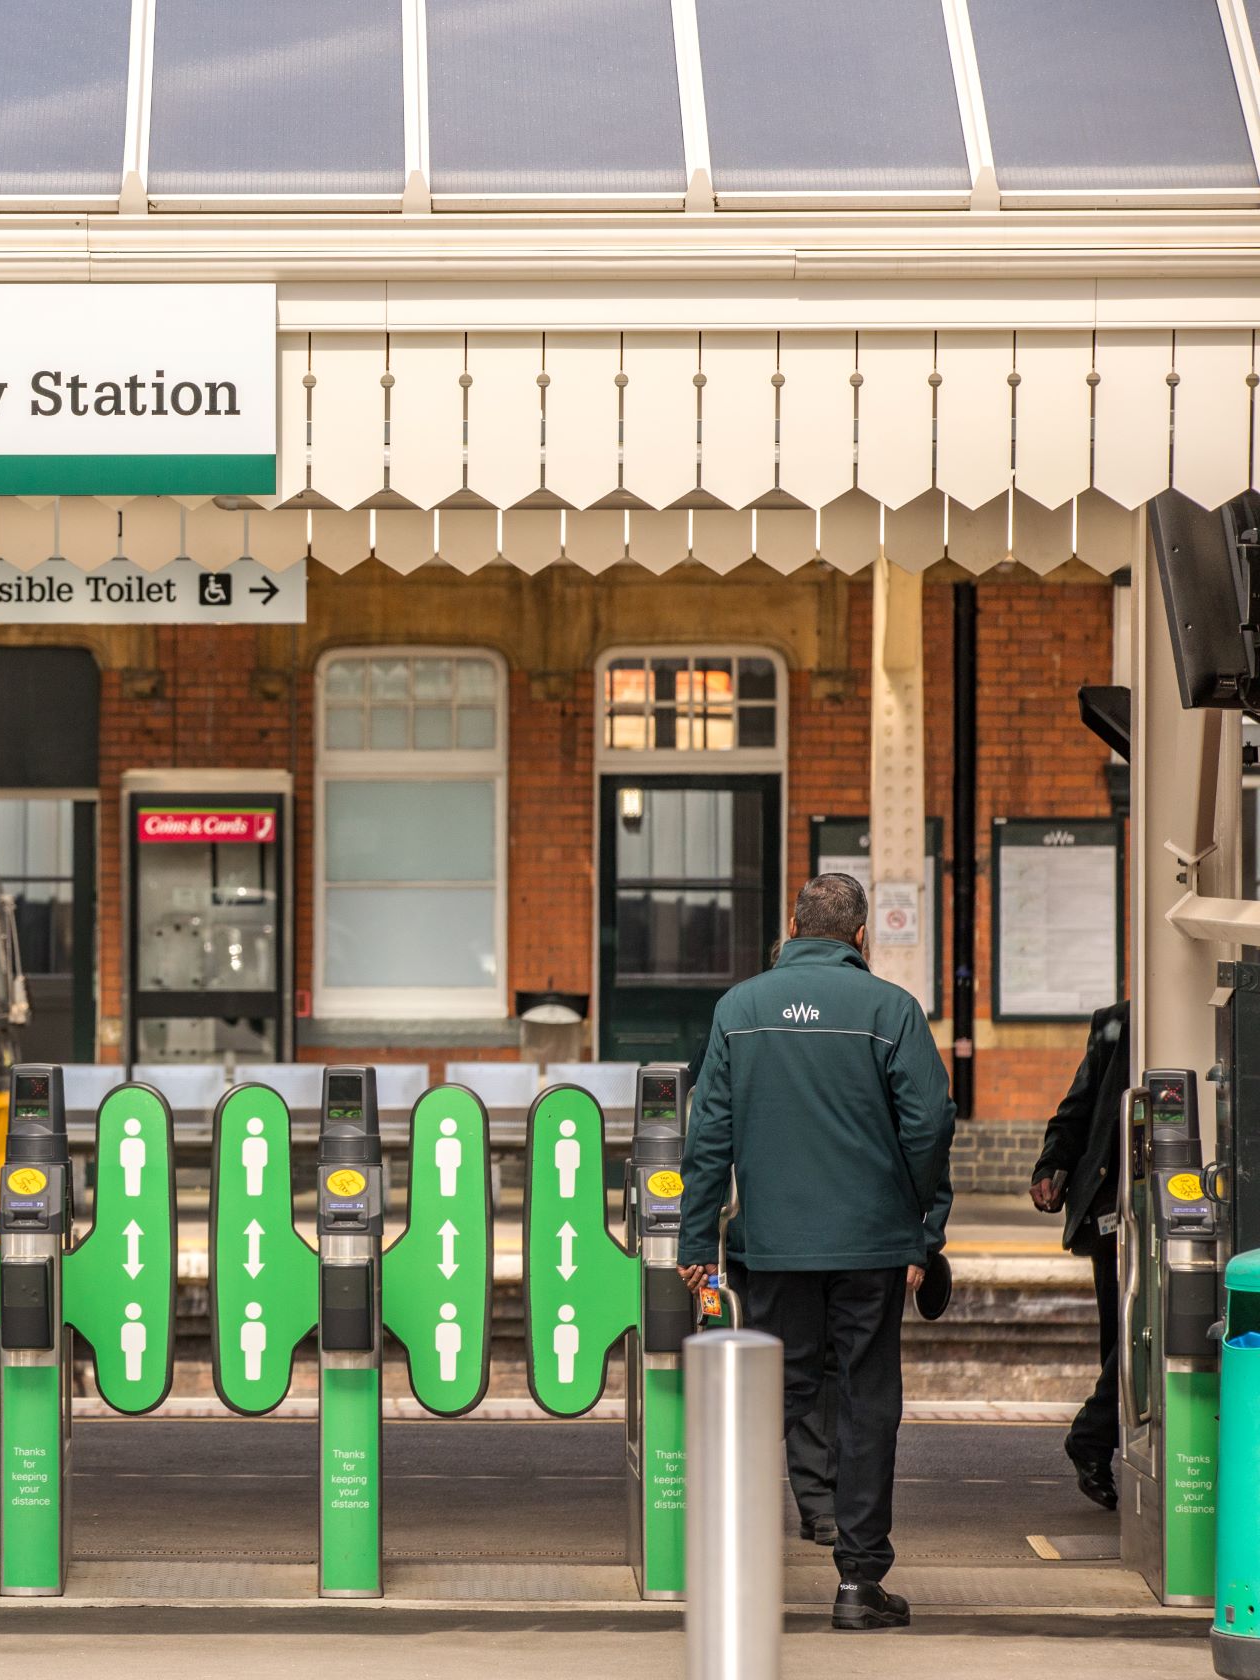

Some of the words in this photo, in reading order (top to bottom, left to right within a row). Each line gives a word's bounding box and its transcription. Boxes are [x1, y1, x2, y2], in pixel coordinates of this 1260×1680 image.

[30, 369, 241, 417] Station
[86, 576, 177, 603] Toilet
[782, 1001, 820, 1024] GWR
[14, 1447, 46, 1456] Thanks
[333, 1449, 365, 1458] Thanks
[1176, 1454, 1210, 1463] Thanks
[23, 1460, 36, 1468] for
[343, 1462, 355, 1471] for
[666, 1463, 678, 1472] for
[1188, 1466, 1200, 1476] for
[12, 1473, 47, 1482] keeping
[332, 1475, 367, 1485] keeping
[1175, 1480, 1212, 1490] keeping
[20, 1486, 40, 1494] your
[339, 1489, 359, 1497] your
[662, 1489, 682, 1497] your
[12, 1497, 50, 1505] distance
[1183, 1494, 1203, 1502] your
[332, 1499, 369, 1508] distance
[1175, 1504, 1215, 1513] distance
